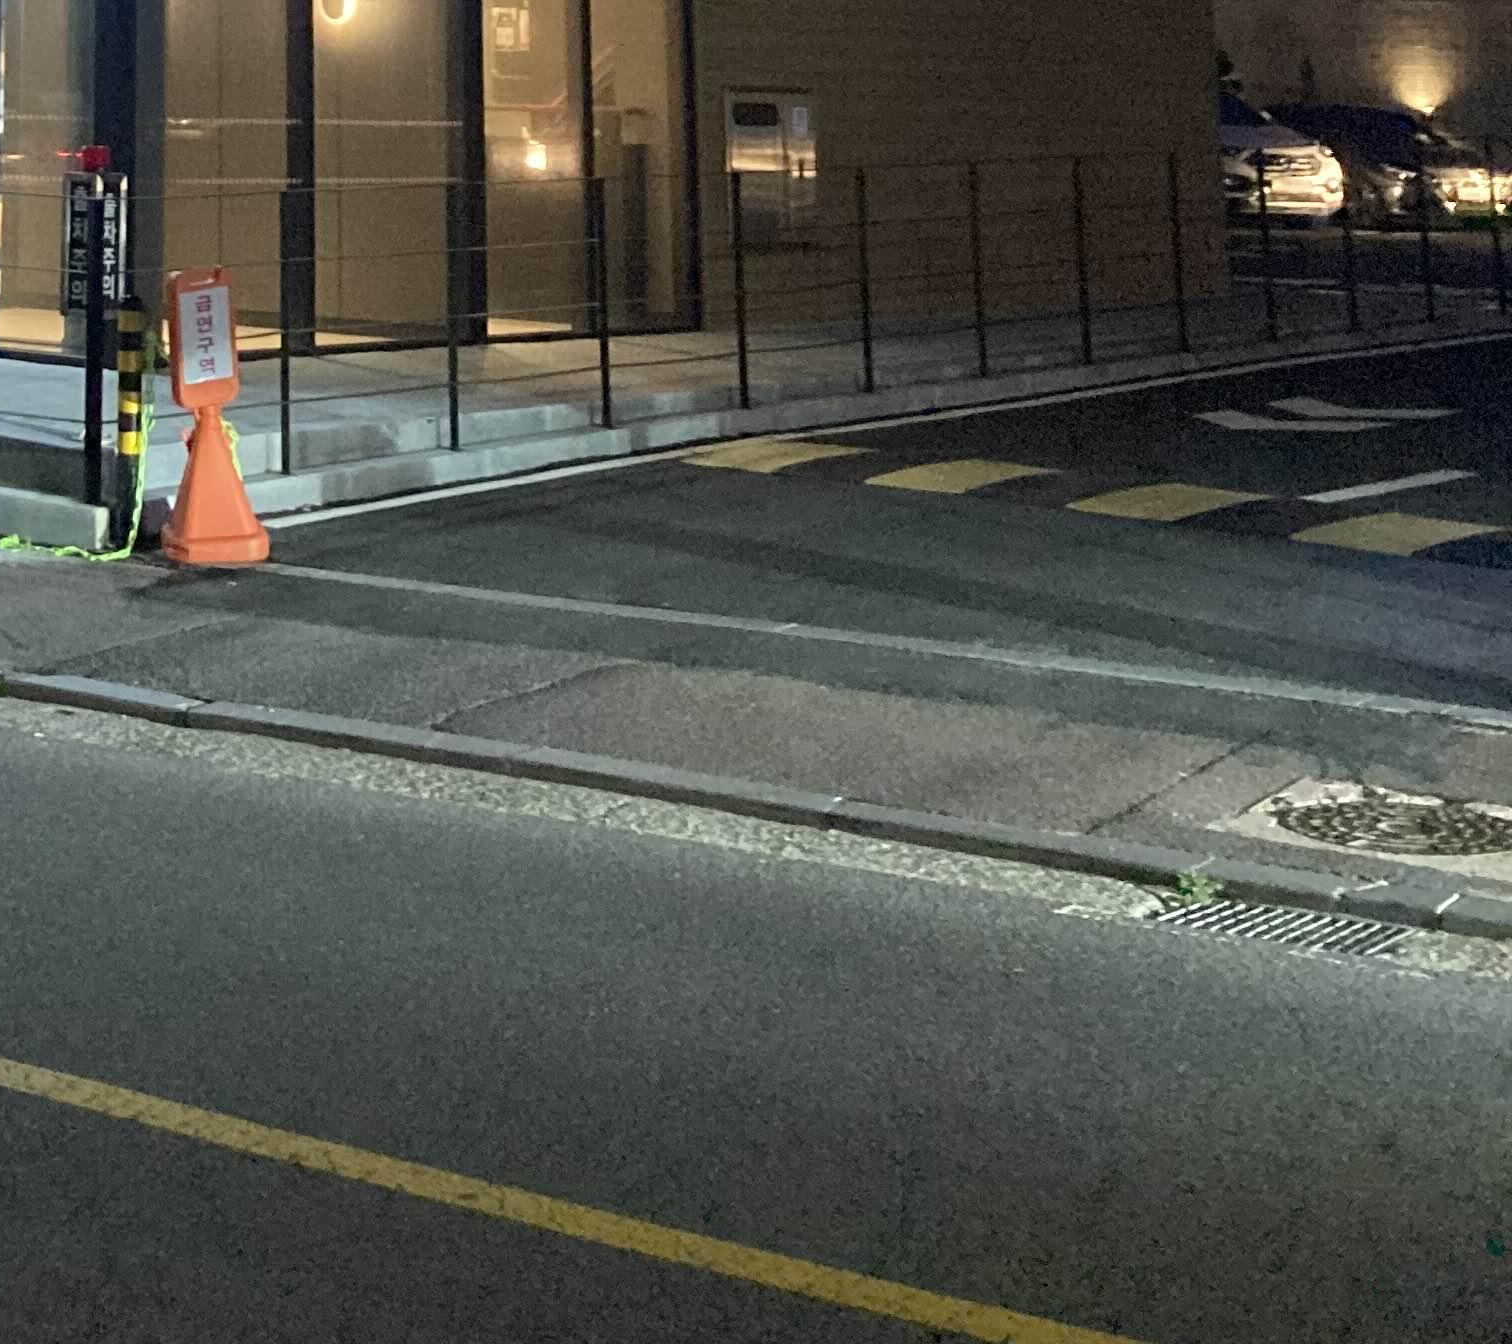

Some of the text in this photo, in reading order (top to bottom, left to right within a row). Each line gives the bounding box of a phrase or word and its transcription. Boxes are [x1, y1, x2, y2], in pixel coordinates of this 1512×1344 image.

[71, 185, 88, 305] 출차주의
[102, 192, 117, 300] 출차주의
[195, 294, 216, 376] 금연구역
